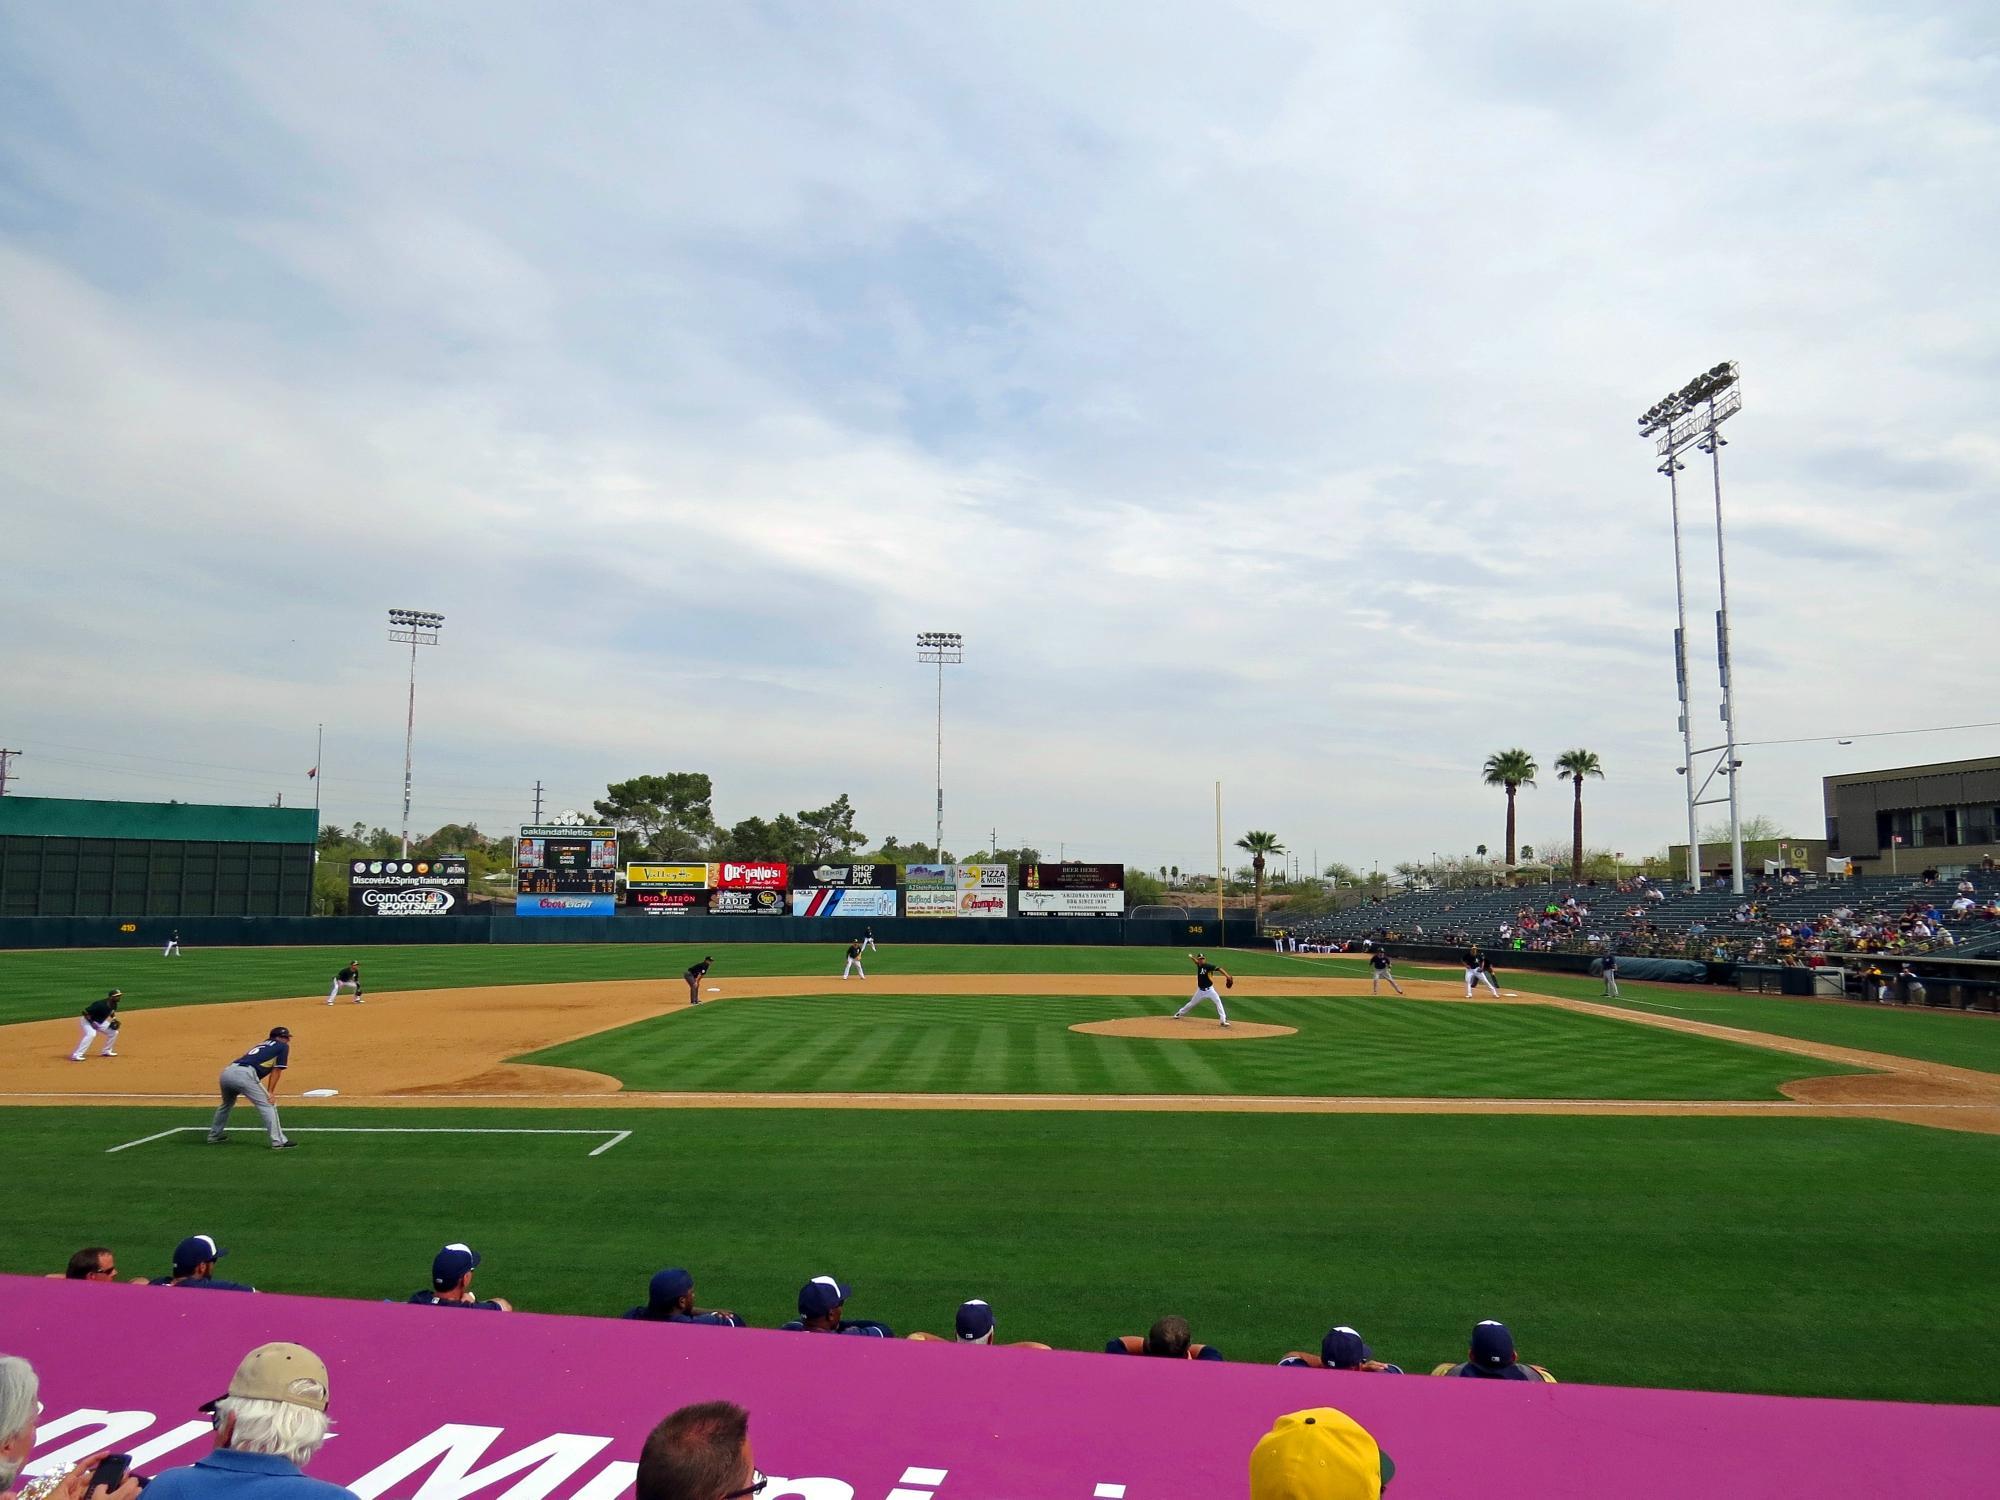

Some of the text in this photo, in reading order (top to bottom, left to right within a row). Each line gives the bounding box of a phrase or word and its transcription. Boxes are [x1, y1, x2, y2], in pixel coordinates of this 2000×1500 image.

[522, 828, 614, 837] oaklandathletics.com
[353, 876, 465, 885] DiscoverAZSpringTraining.com
[378, 902, 443, 910] SPORTSNET
[540, 898, 593, 909] Coors LIGHT
[1189, 925, 1203, 933] 345
